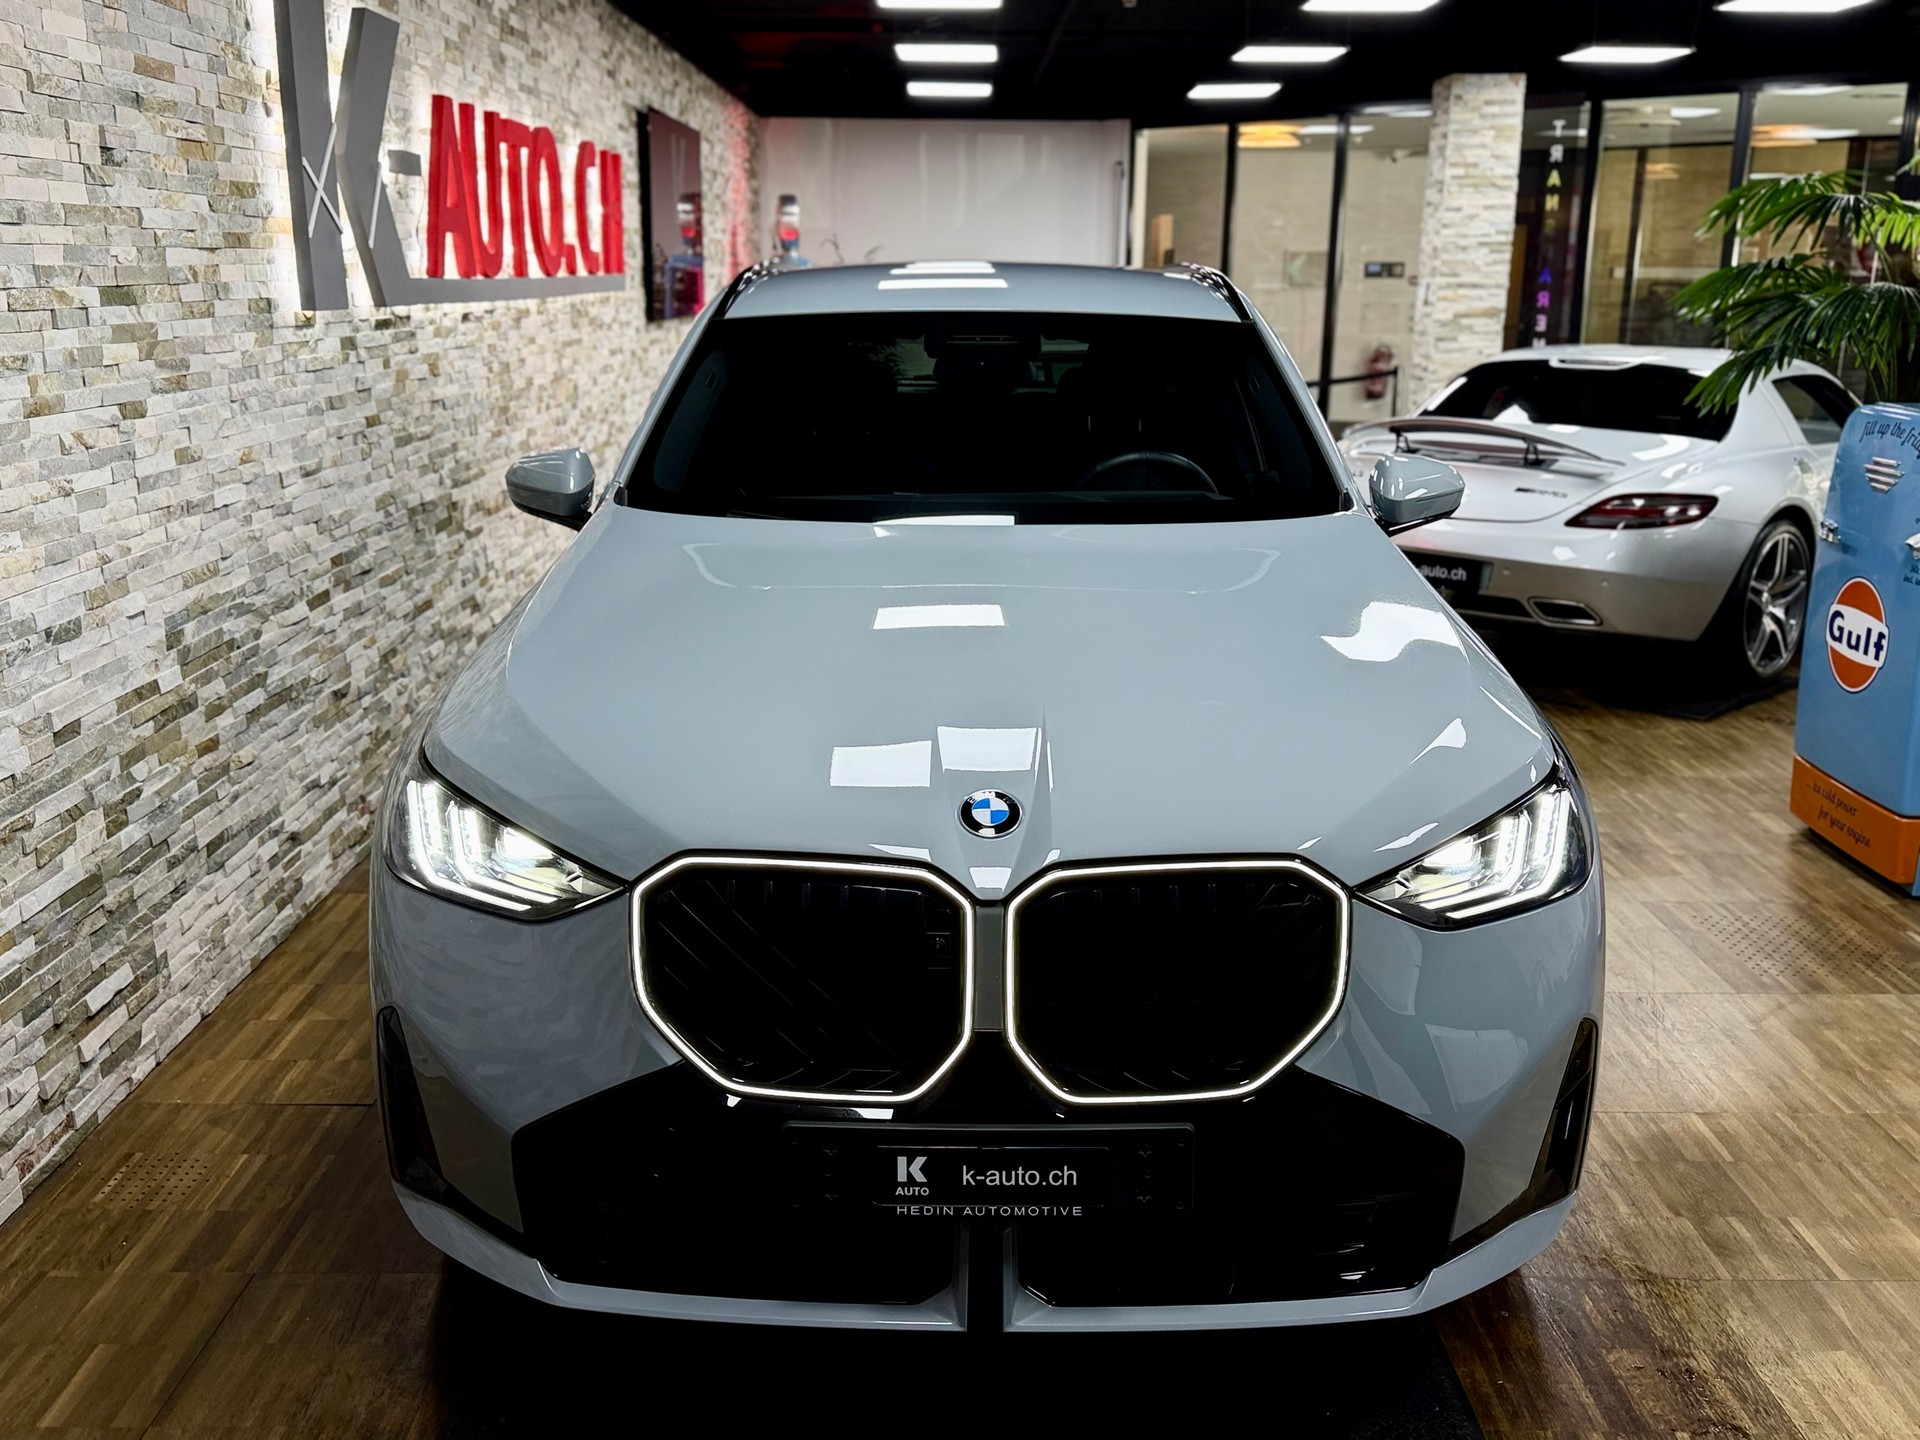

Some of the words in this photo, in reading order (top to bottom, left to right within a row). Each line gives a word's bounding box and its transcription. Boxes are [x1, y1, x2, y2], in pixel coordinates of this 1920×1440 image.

[1859, 420, 1878, 443] fill
[1877, 423, 1891, 439] up
[1890, 422, 1906, 439] the
[1416, 564, 1467, 581] -auto.ch
[1829, 610, 1886, 662] Gulf
[1835, 798, 1858, 816] power
[1818, 805, 1829, 820] for
[1829, 815, 1846, 831] your
[897, 1156, 928, 1182] K
[962, 1165, 1077, 1186] k-auto.ch
[895, 1187, 930, 1196] AUTO
[896, 1205, 954, 1216] HEDIN
[962, 1206, 1083, 1216] AUTOMOTIVE
